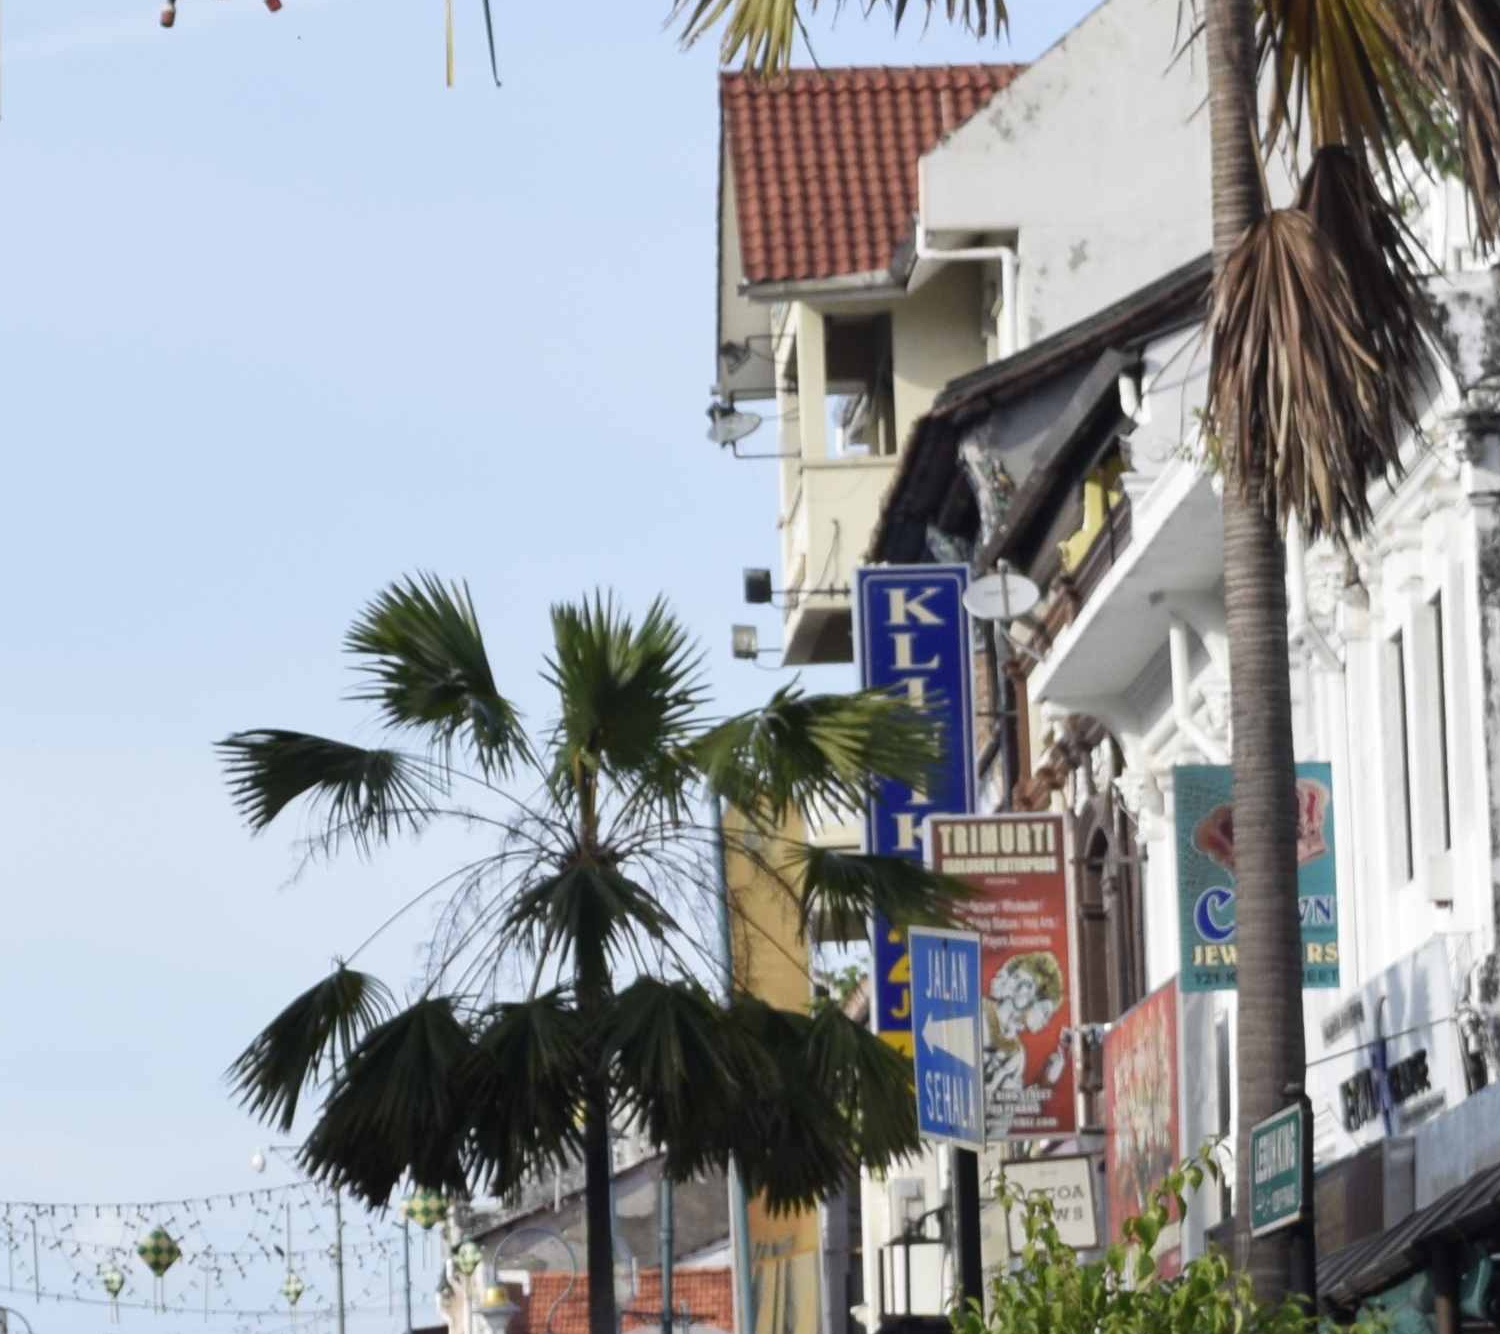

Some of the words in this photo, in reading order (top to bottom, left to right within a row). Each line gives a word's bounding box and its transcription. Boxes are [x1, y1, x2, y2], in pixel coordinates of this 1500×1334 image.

[938, 822, 1056, 855] TRIMURTI
[926, 949, 968, 1002] JALAN
[926, 1070, 977, 1129] SEHALA
